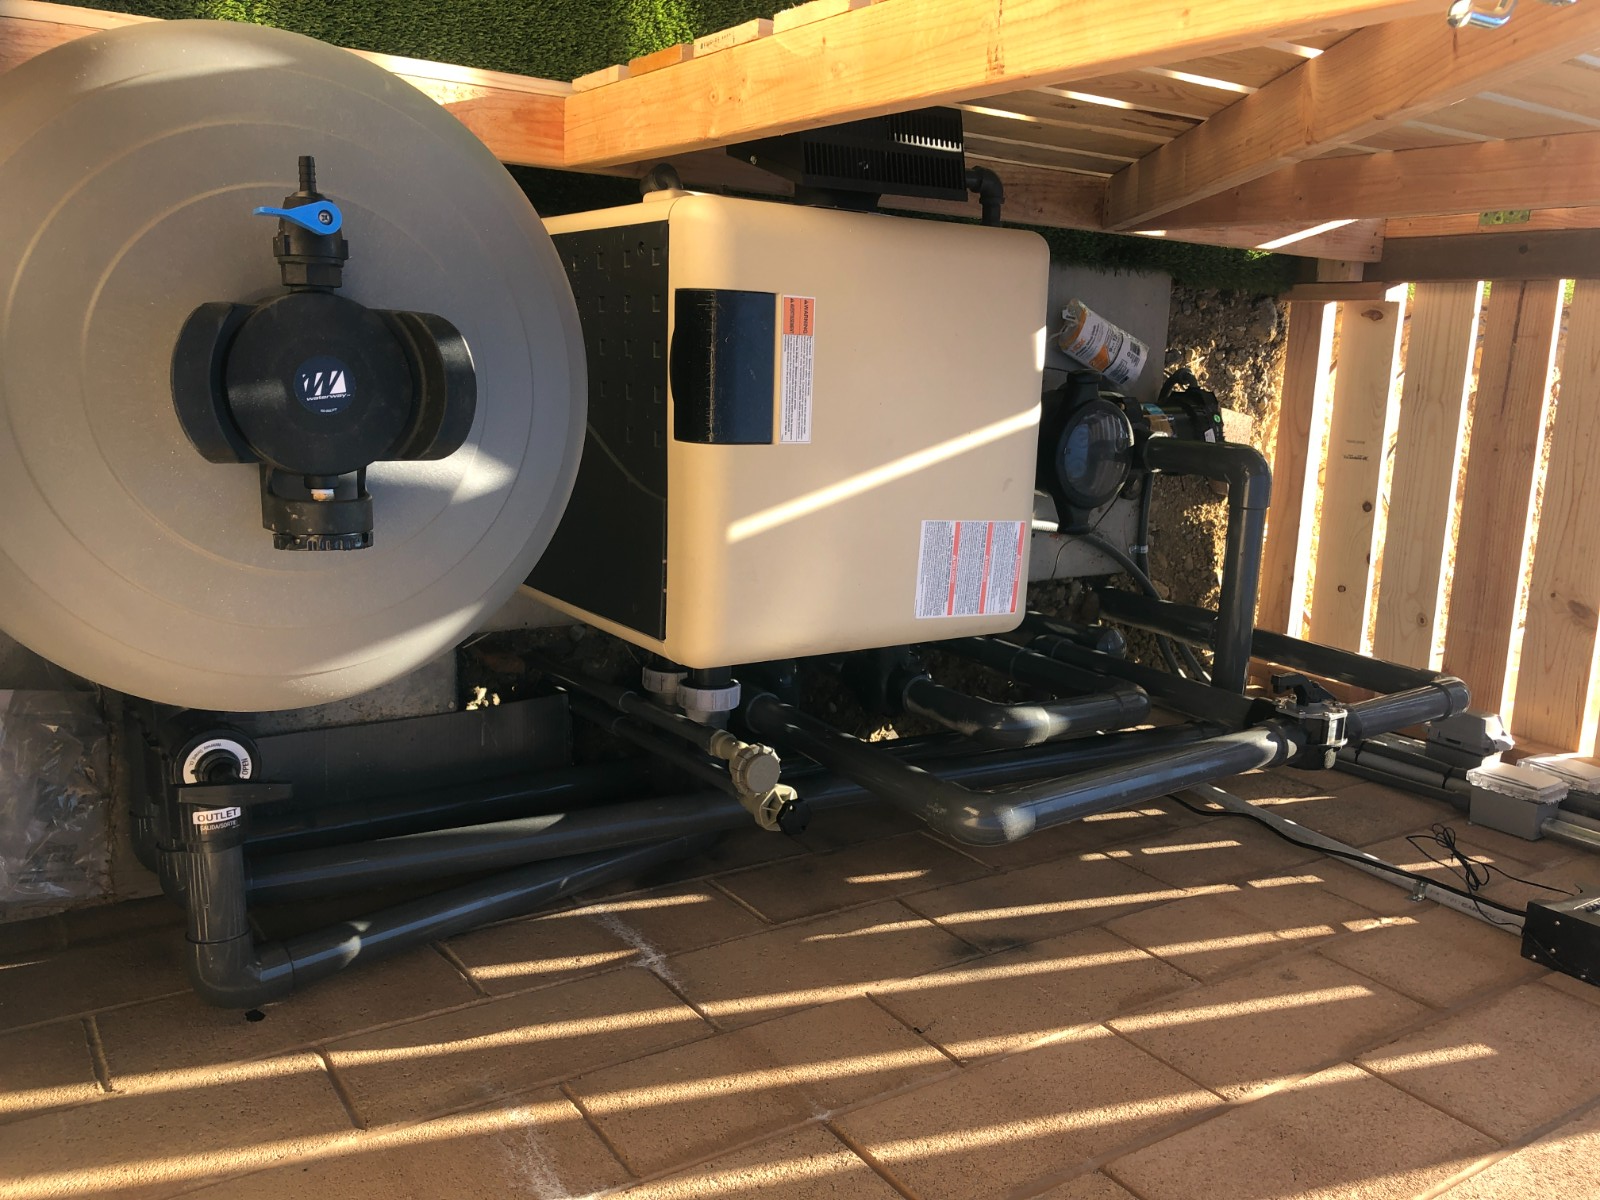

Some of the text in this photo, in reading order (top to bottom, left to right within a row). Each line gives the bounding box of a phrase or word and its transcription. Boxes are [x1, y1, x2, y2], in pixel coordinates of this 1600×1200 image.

[306, 394, 347, 402] waterway
[241, 757, 249, 775] OPEN
[197, 807, 238, 822] OUTLET
